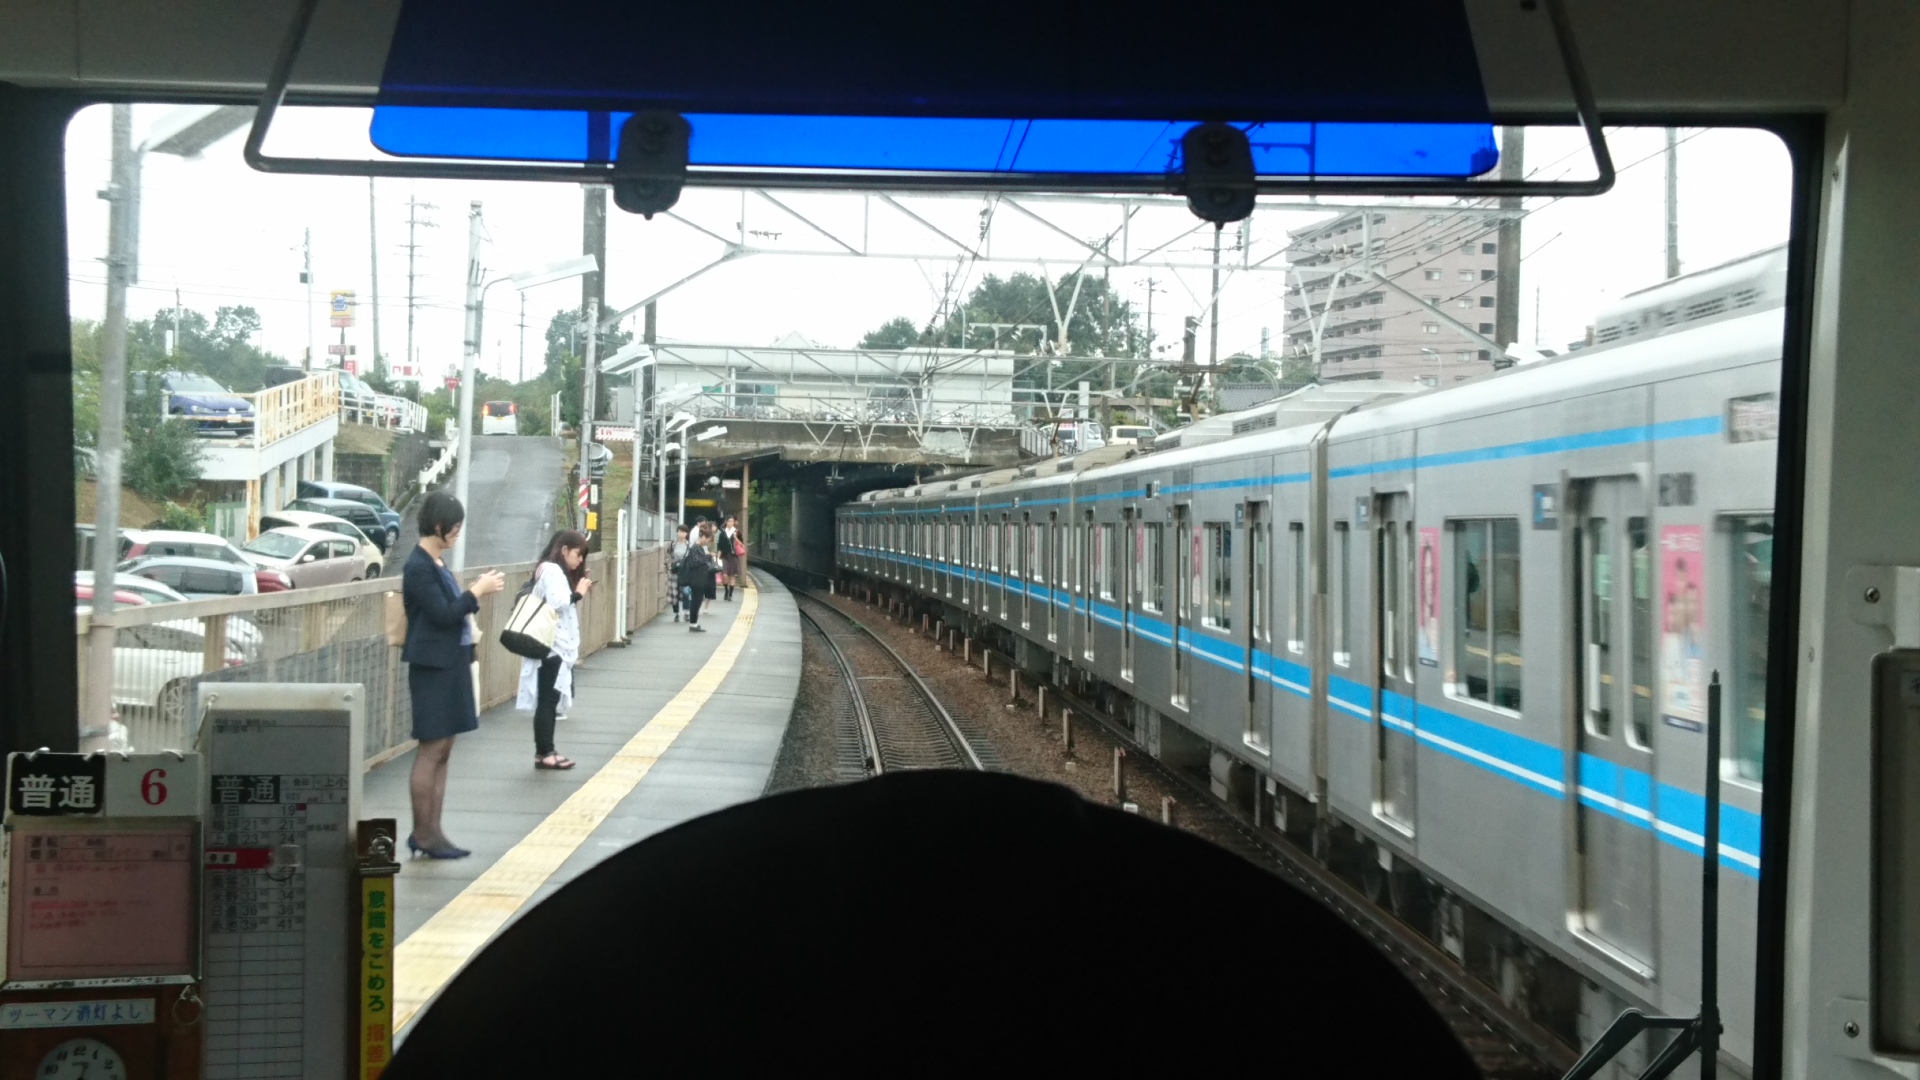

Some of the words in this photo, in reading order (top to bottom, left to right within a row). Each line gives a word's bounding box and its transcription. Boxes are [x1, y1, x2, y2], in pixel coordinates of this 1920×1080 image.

[18, 774, 97, 810] 普通
[141, 768, 168, 806] 6
[215, 775, 276, 803] 普通
